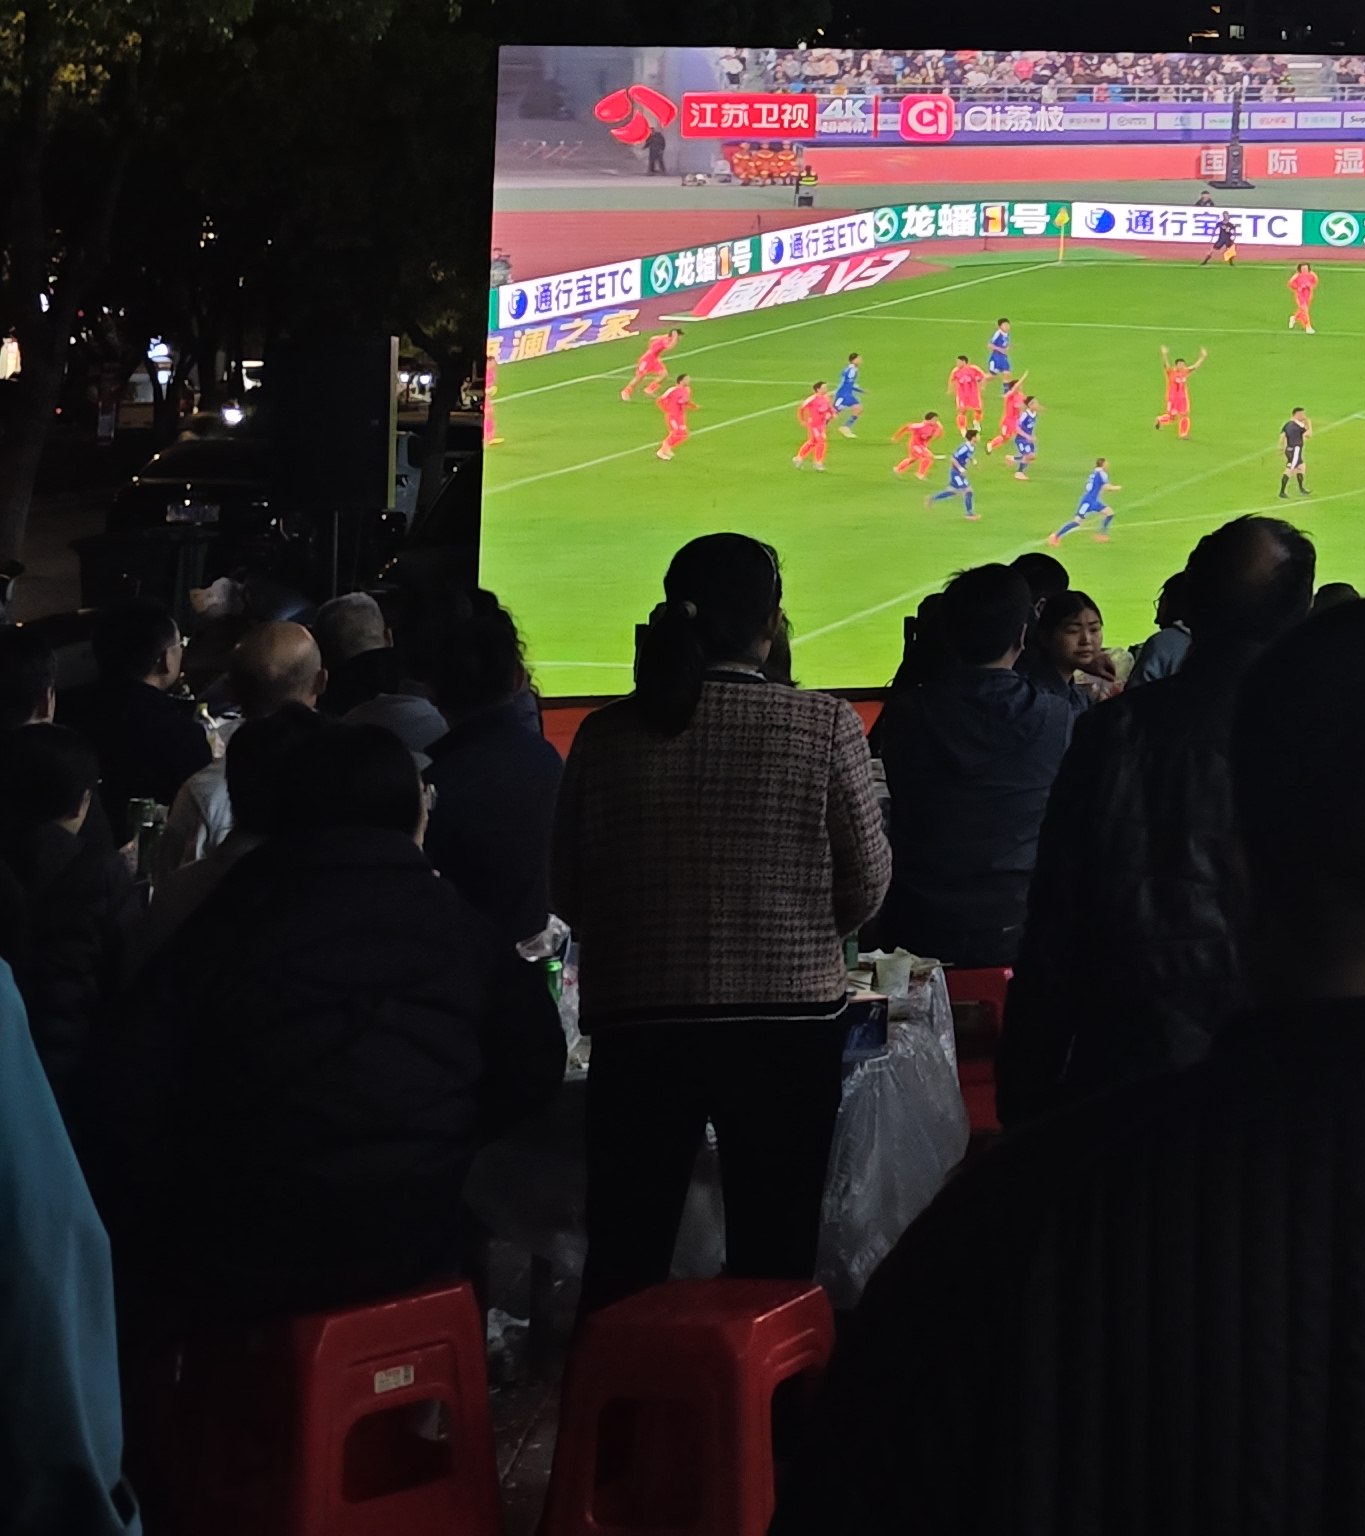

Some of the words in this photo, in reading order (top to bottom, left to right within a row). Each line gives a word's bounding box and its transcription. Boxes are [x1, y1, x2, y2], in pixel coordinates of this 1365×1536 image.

[688, 101, 810, 130] 江苏卫视
[786, 218, 869, 261] 通行宝ETC
[534, 261, 634, 314] 通行宝ETC
